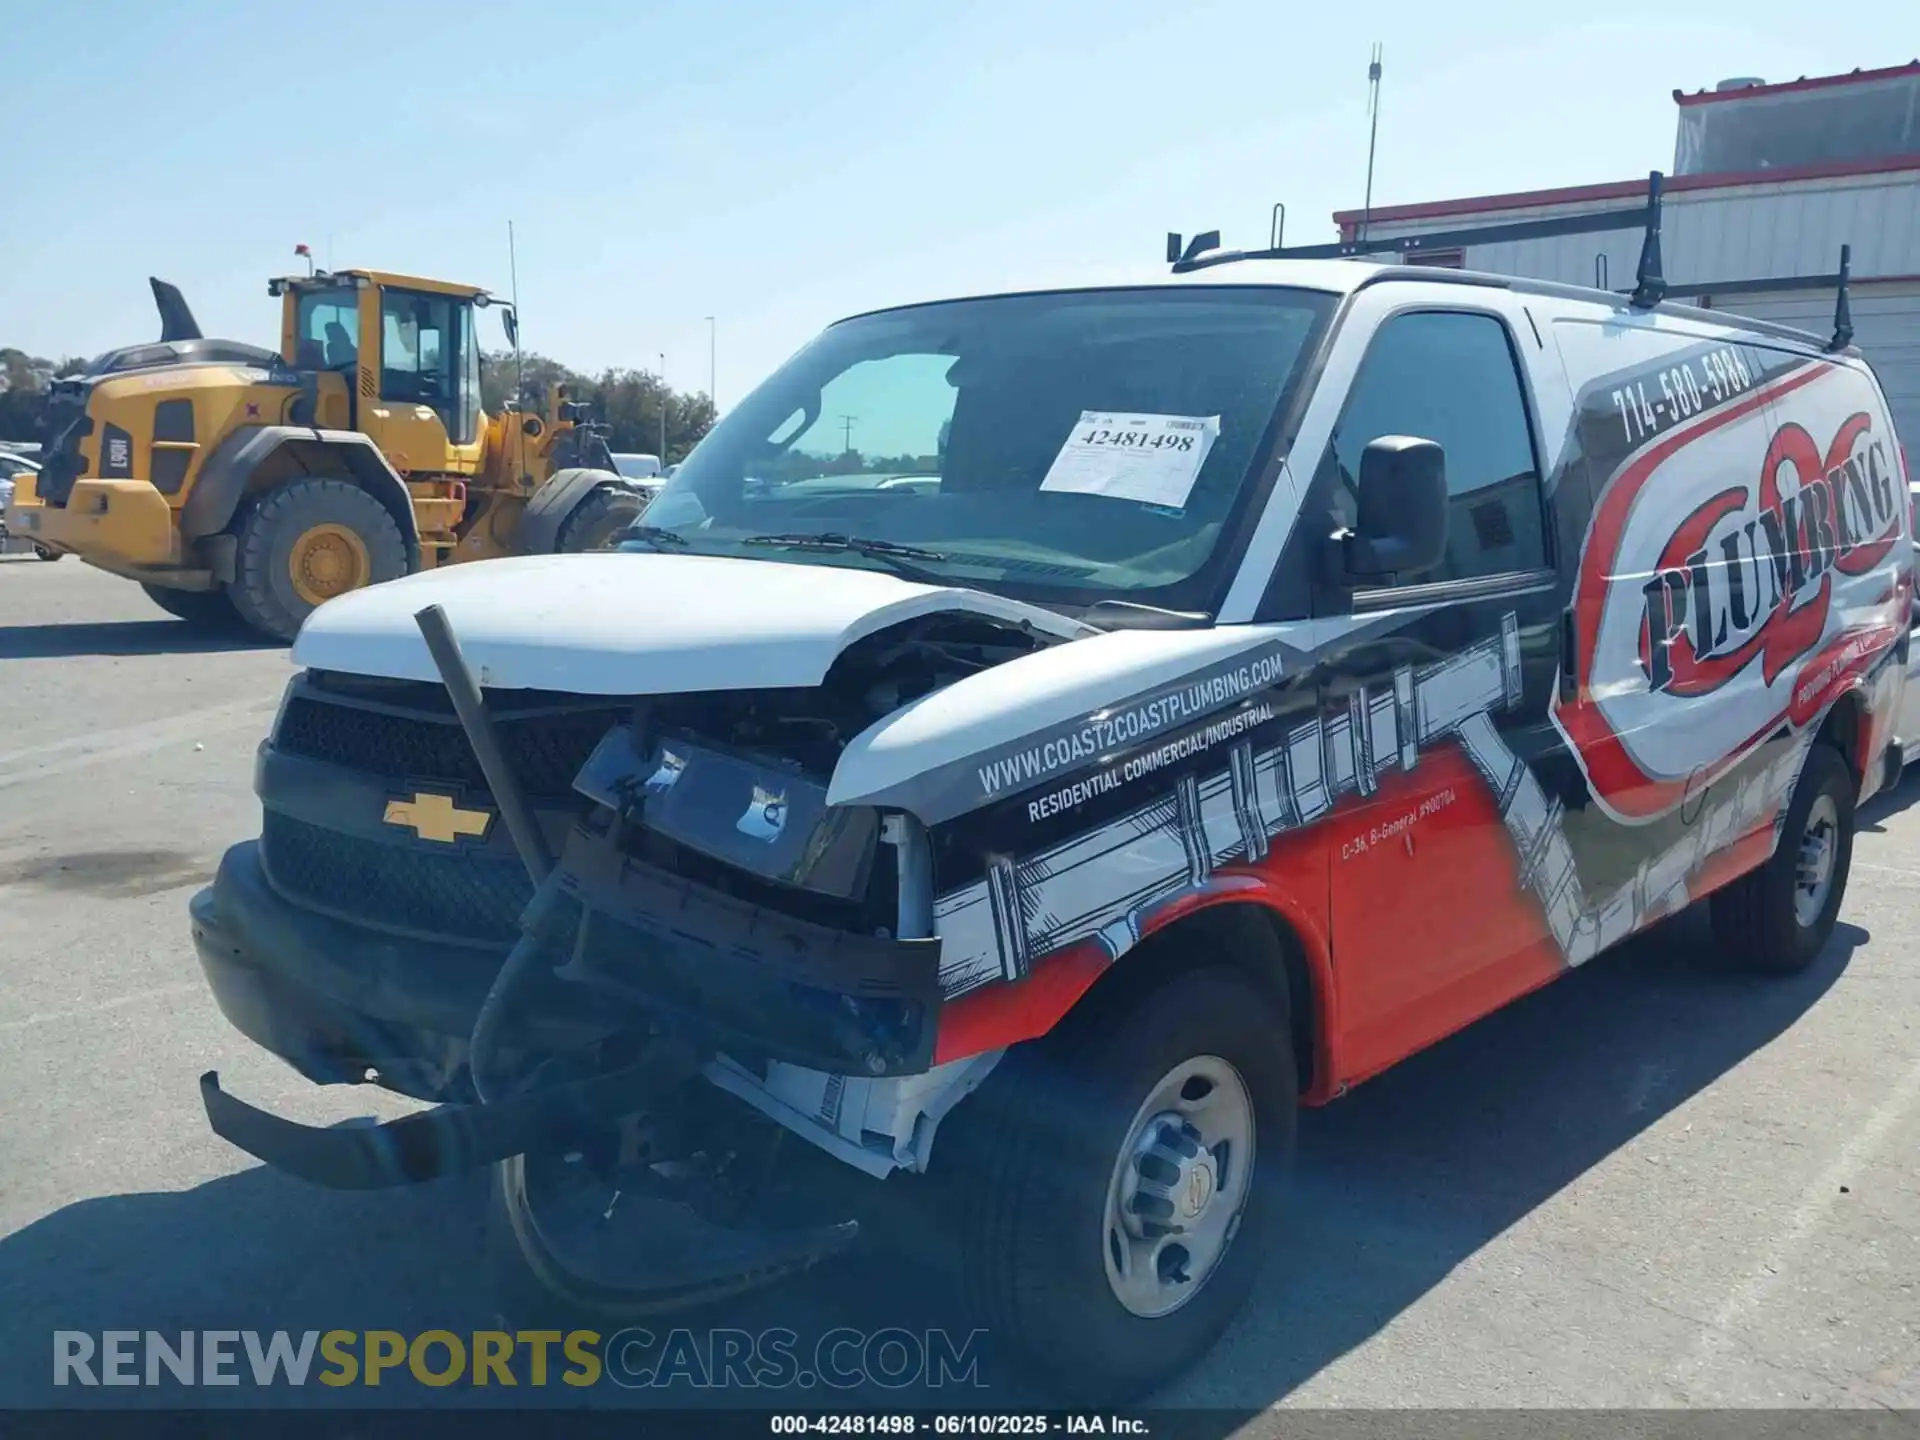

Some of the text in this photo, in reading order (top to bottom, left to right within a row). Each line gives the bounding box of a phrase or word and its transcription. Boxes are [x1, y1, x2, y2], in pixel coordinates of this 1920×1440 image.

[1081, 430, 1195, 452] 42481498
[1612, 345, 1751, 443] 714-580-5986
[1642, 437, 1894, 693] PLUMBING
[978, 653, 1282, 795] WWW.COAST2COASTPLUMBING.COM
[1028, 702, 1274, 823] RESIDENTIAL COMMERCIAL/INDUSTRIAL
[1370, 807, 1417, 846] B-General
